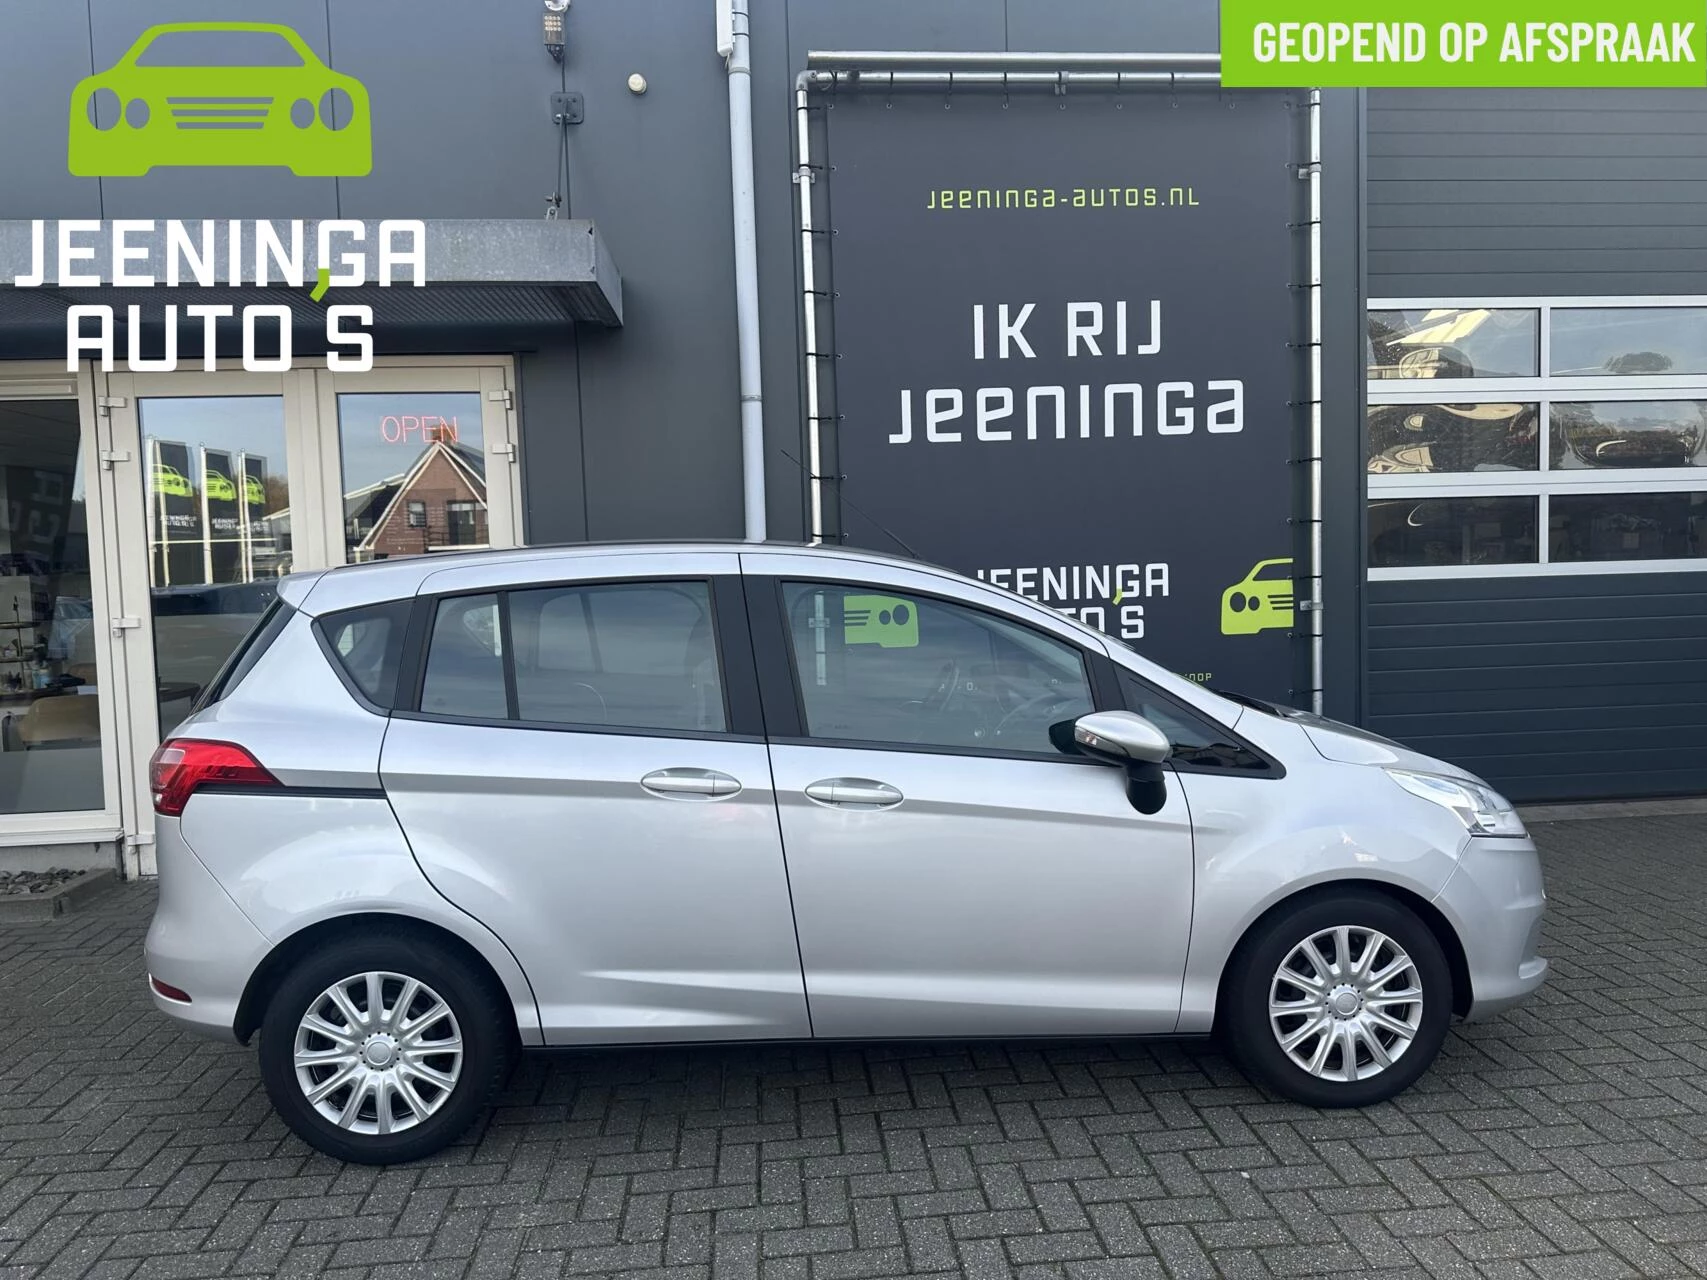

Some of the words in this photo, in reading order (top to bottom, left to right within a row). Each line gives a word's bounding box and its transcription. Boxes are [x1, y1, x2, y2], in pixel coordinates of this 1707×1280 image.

[974, 304, 1036, 360] IK
[1067, 301, 1162, 357] RIJ
[381, 415, 458, 442] OPEN
